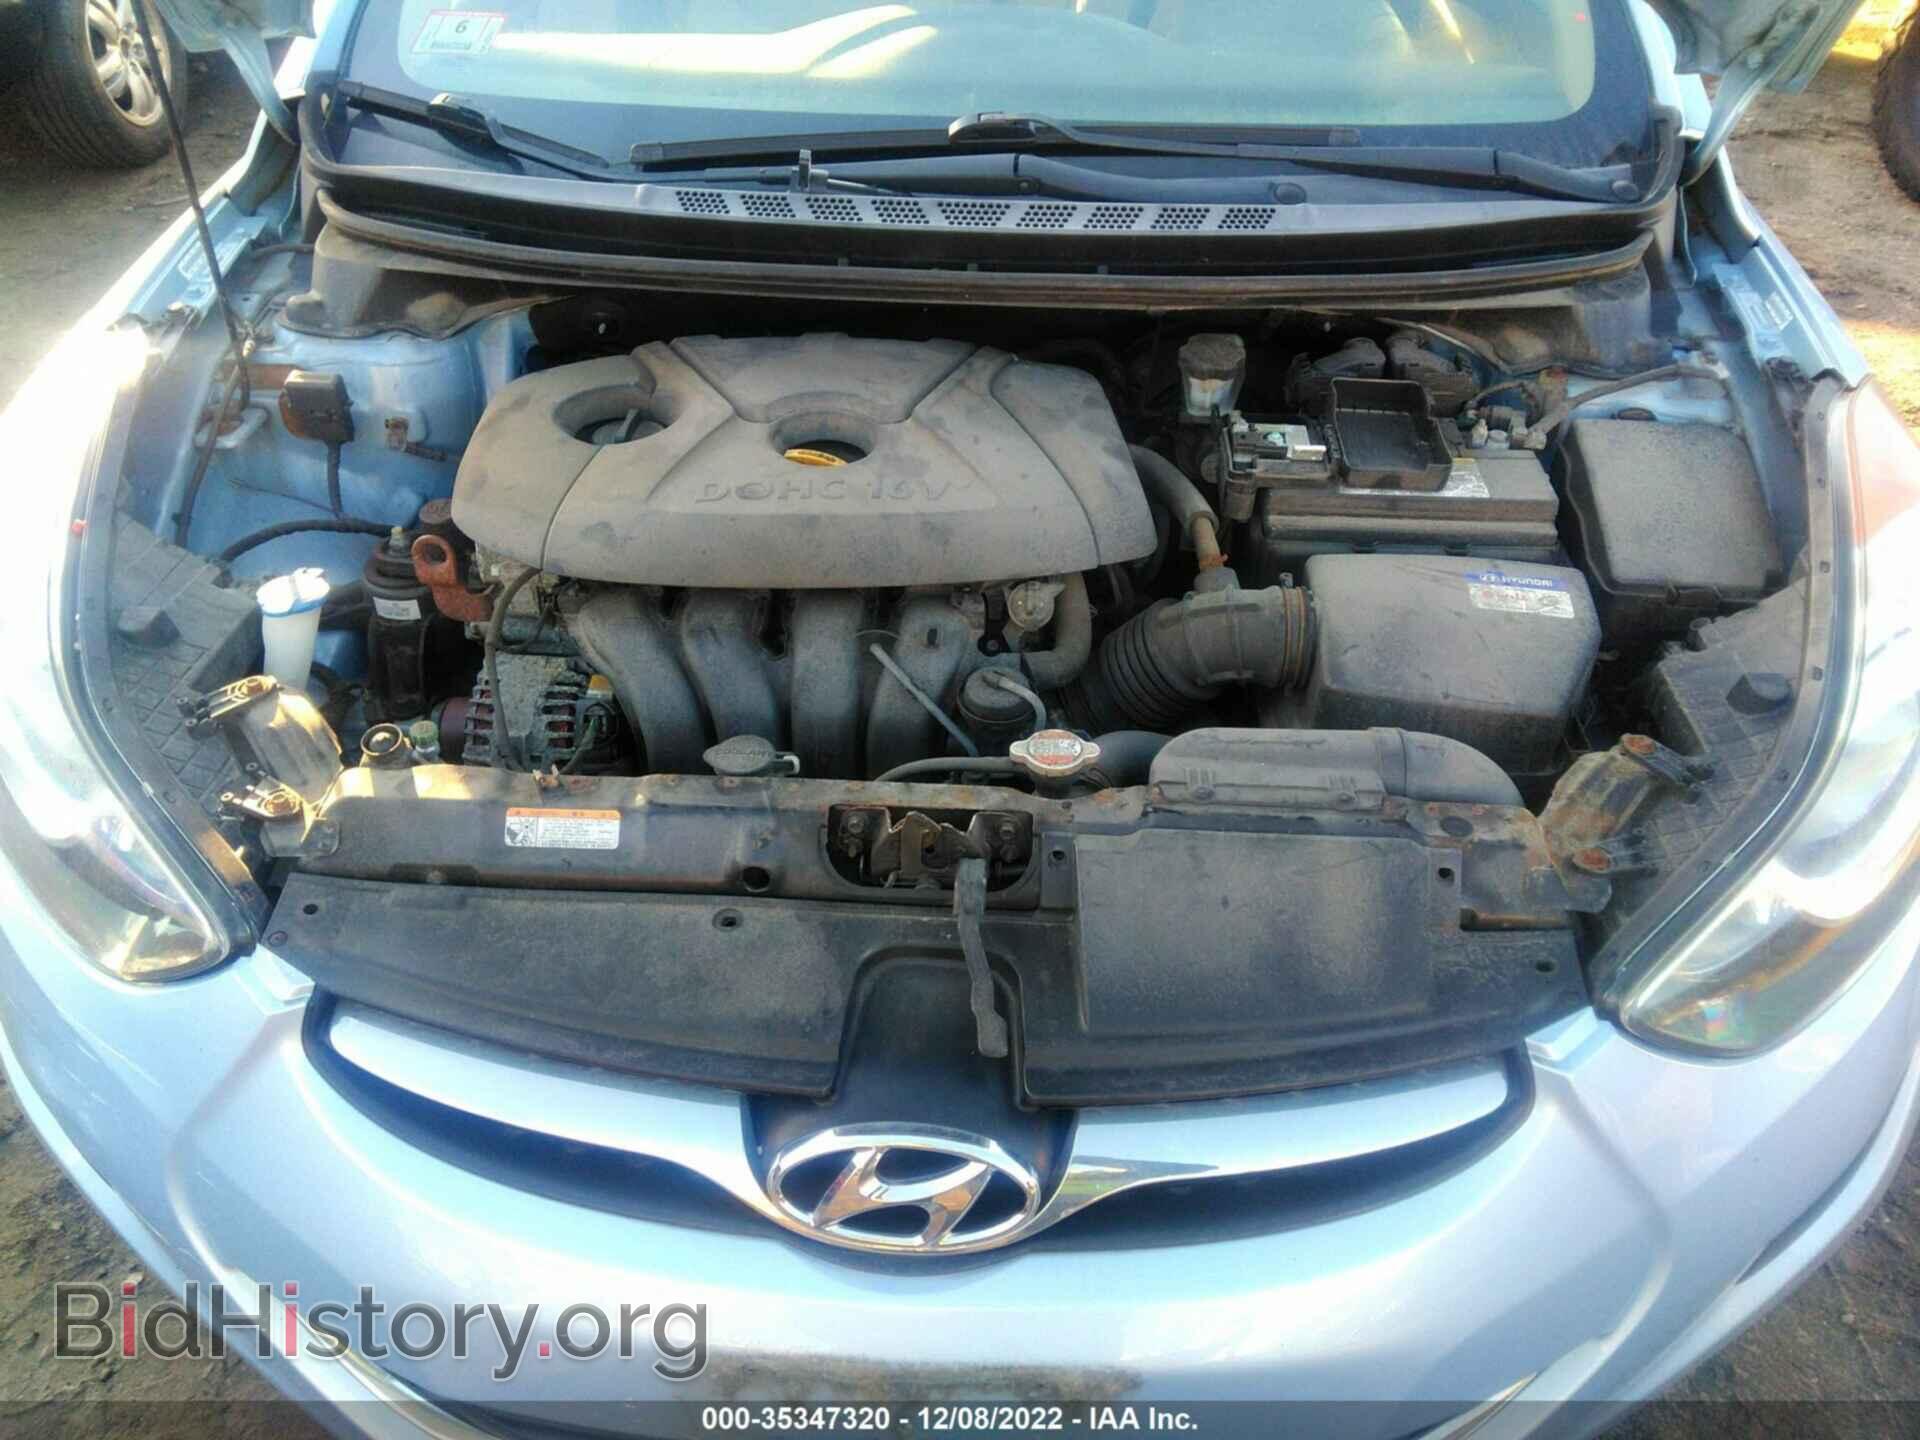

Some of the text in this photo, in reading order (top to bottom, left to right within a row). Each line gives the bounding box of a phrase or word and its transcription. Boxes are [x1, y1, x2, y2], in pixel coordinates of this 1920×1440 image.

[455, 20, 470, 33] 6
[695, 479, 952, 502] DOHC 16V
